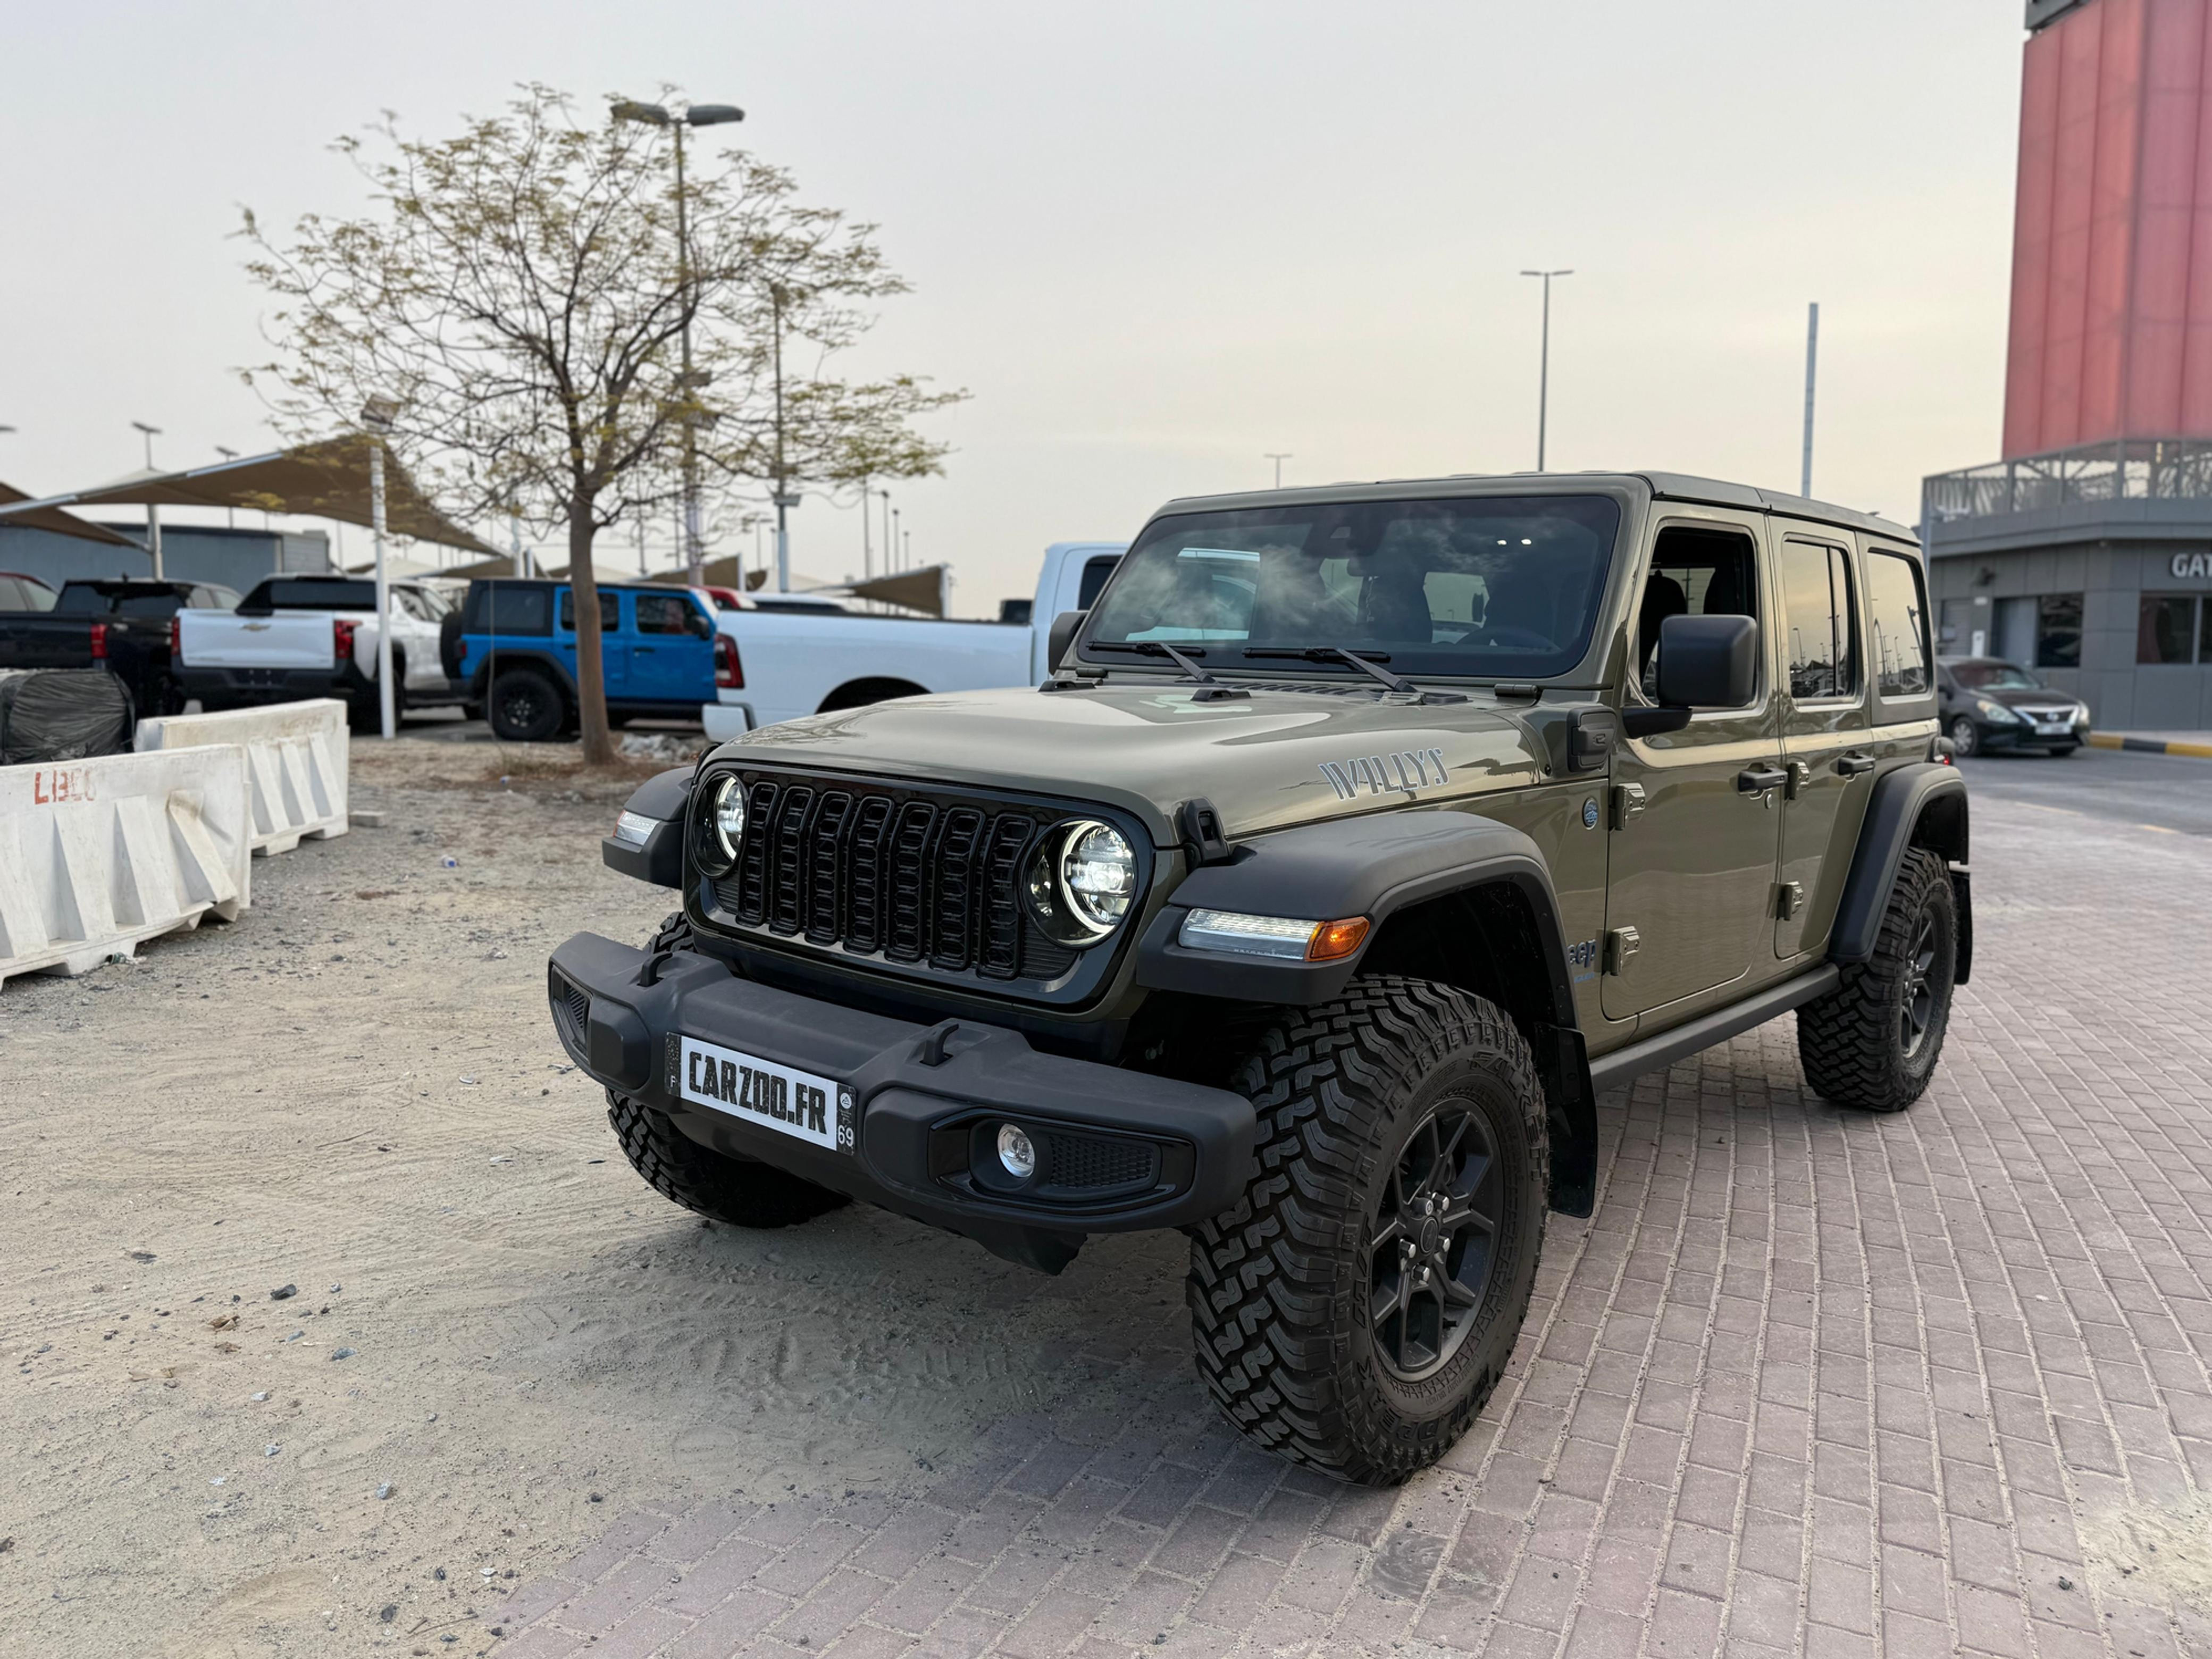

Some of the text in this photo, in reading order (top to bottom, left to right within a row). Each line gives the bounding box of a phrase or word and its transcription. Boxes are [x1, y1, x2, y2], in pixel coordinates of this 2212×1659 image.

[1318, 748, 1449, 801] WILLYS
[1567, 939, 1596, 968] eep
[670, 1075, 677, 1088] F
[689, 1051, 827, 1134] CARZOO.FR
[838, 1125, 854, 1147] 69
